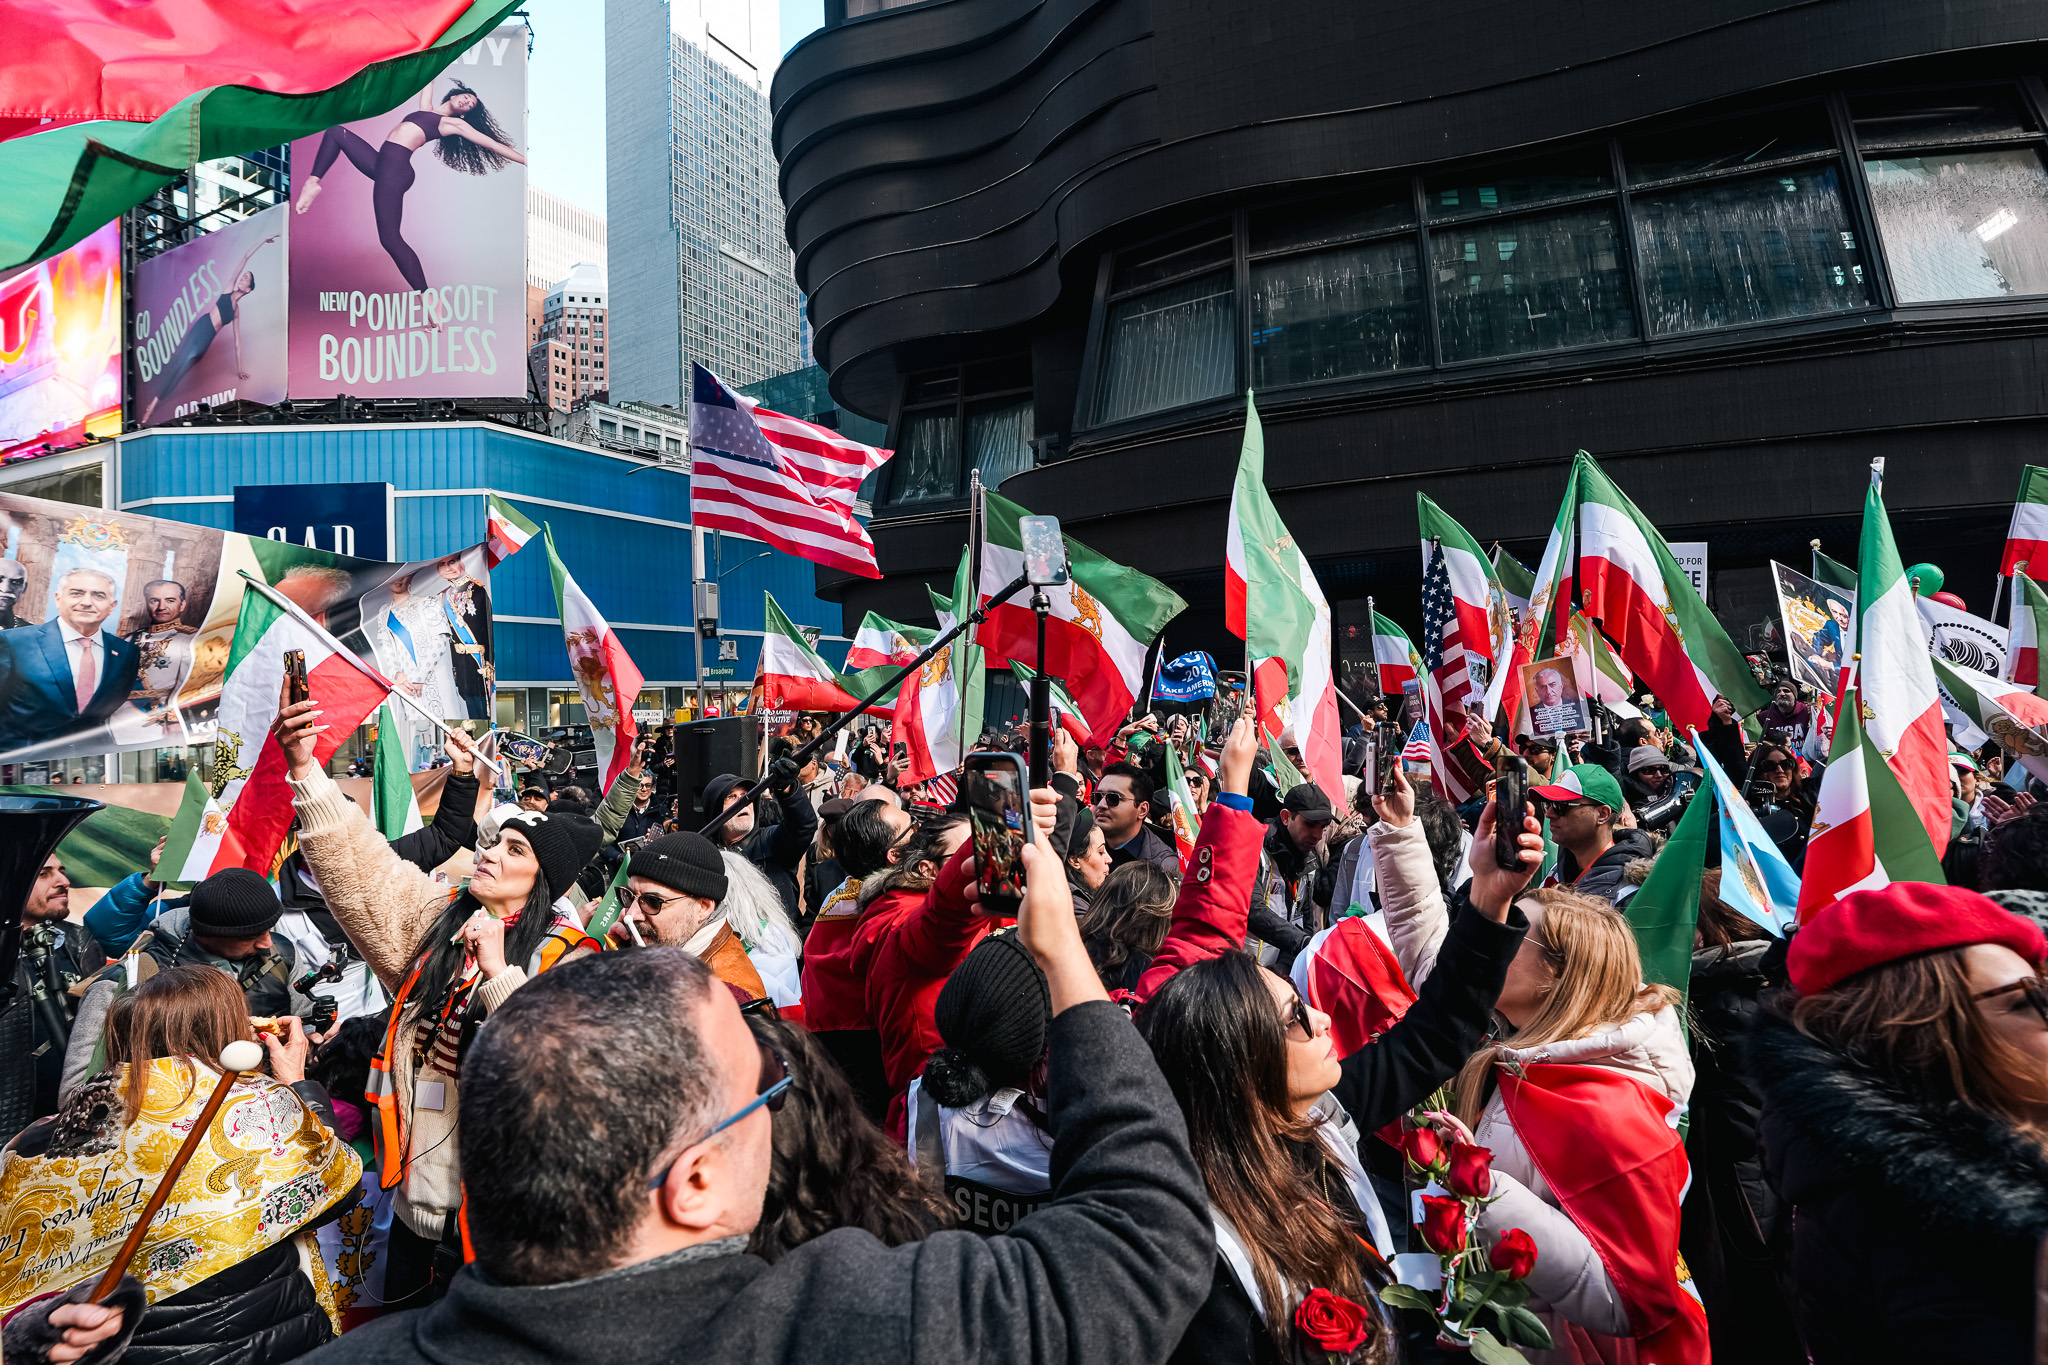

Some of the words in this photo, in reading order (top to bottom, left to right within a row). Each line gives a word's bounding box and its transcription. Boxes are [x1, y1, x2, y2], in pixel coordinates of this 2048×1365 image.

[452, 37, 511, 67] VY
[136, 259, 222, 383] BOUNDLESS
[320, 292, 348, 311] NEW
[350, 284, 497, 331] POWERSOFT
[136, 310, 150, 340] GO
[319, 326, 497, 384] BOUNDLESS
[711, 668, 733, 676] Broadway
[1161, 684, 1183, 693] TAKE
[1186, 680, 1216, 692] AMERIC
[190, 720, 218, 733] KI
[41, 1162, 143, 1235] Empress
[156, 1203, 180, 1224] He
[955, 1187, 1051, 1231] SEC
[83, 1210, 137, 1264] mperial
[20, 1249, 81, 1281] Majesty
